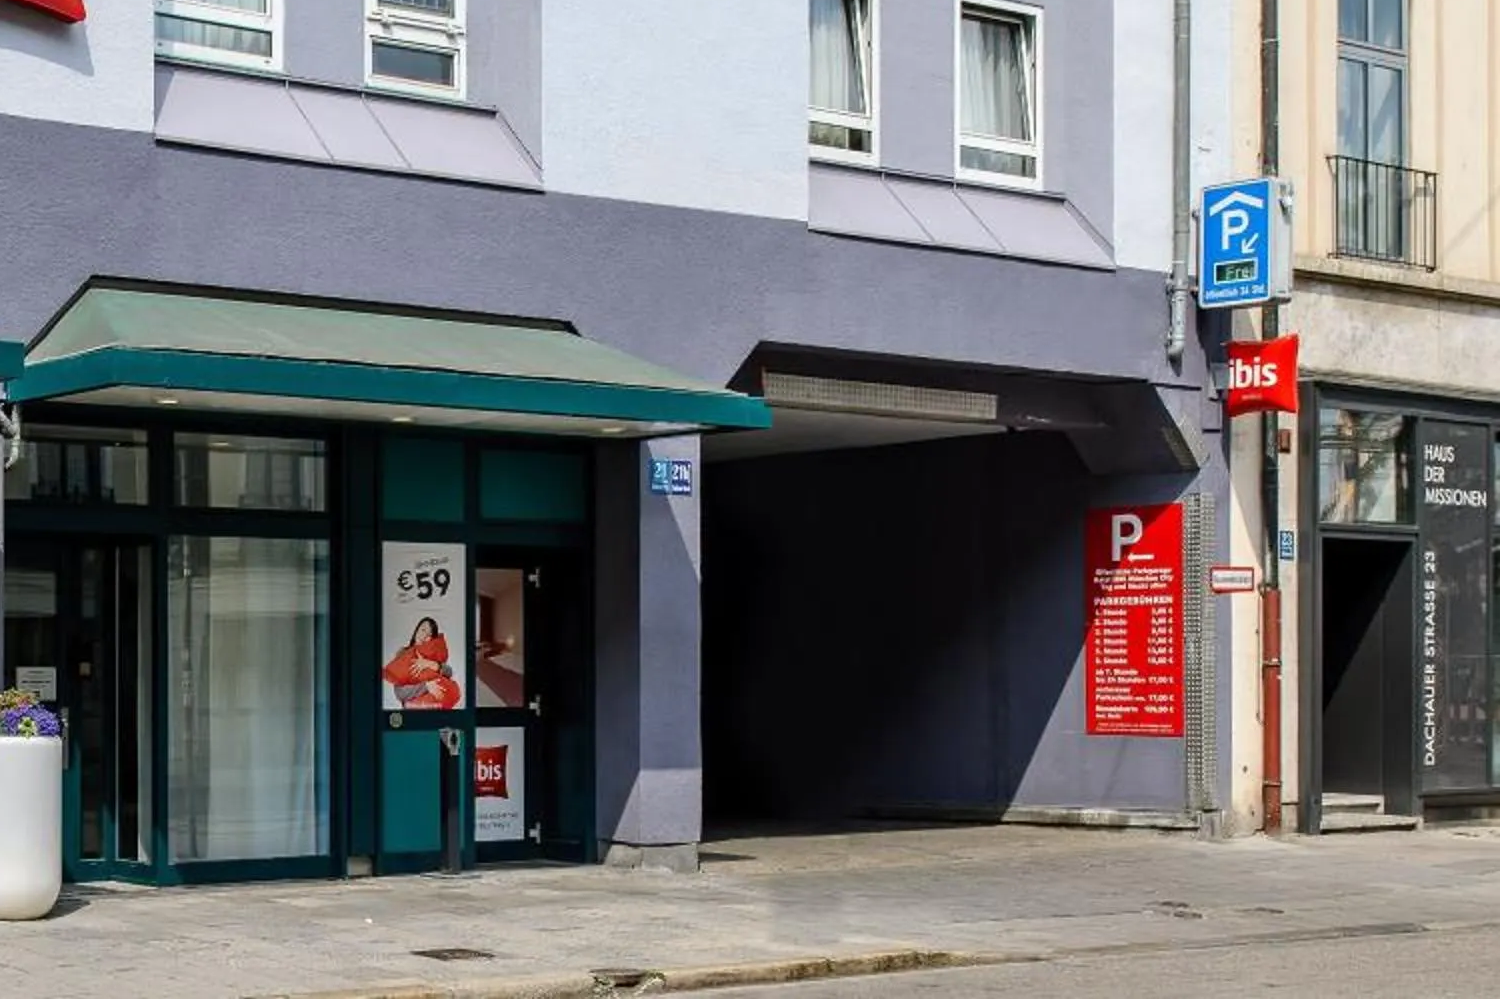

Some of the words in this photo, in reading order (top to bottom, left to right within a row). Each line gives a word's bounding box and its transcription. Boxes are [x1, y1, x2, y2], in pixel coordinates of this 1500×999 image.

[1221, 208, 1248, 250] P
[1228, 357, 1278, 389] ibis
[1424, 444, 1455, 462] HAUS
[1424, 465, 1445, 483] DER
[1424, 487, 1487, 508] MISSIONEN
[1111, 514, 1143, 561] P
[1423, 551, 1436, 573] 23
[397, 568, 451, 600] €59
[1423, 580, 1436, 657] STRASSE
[1423, 663, 1436, 767] DACHAUER
[476, 758, 503, 782] bis
